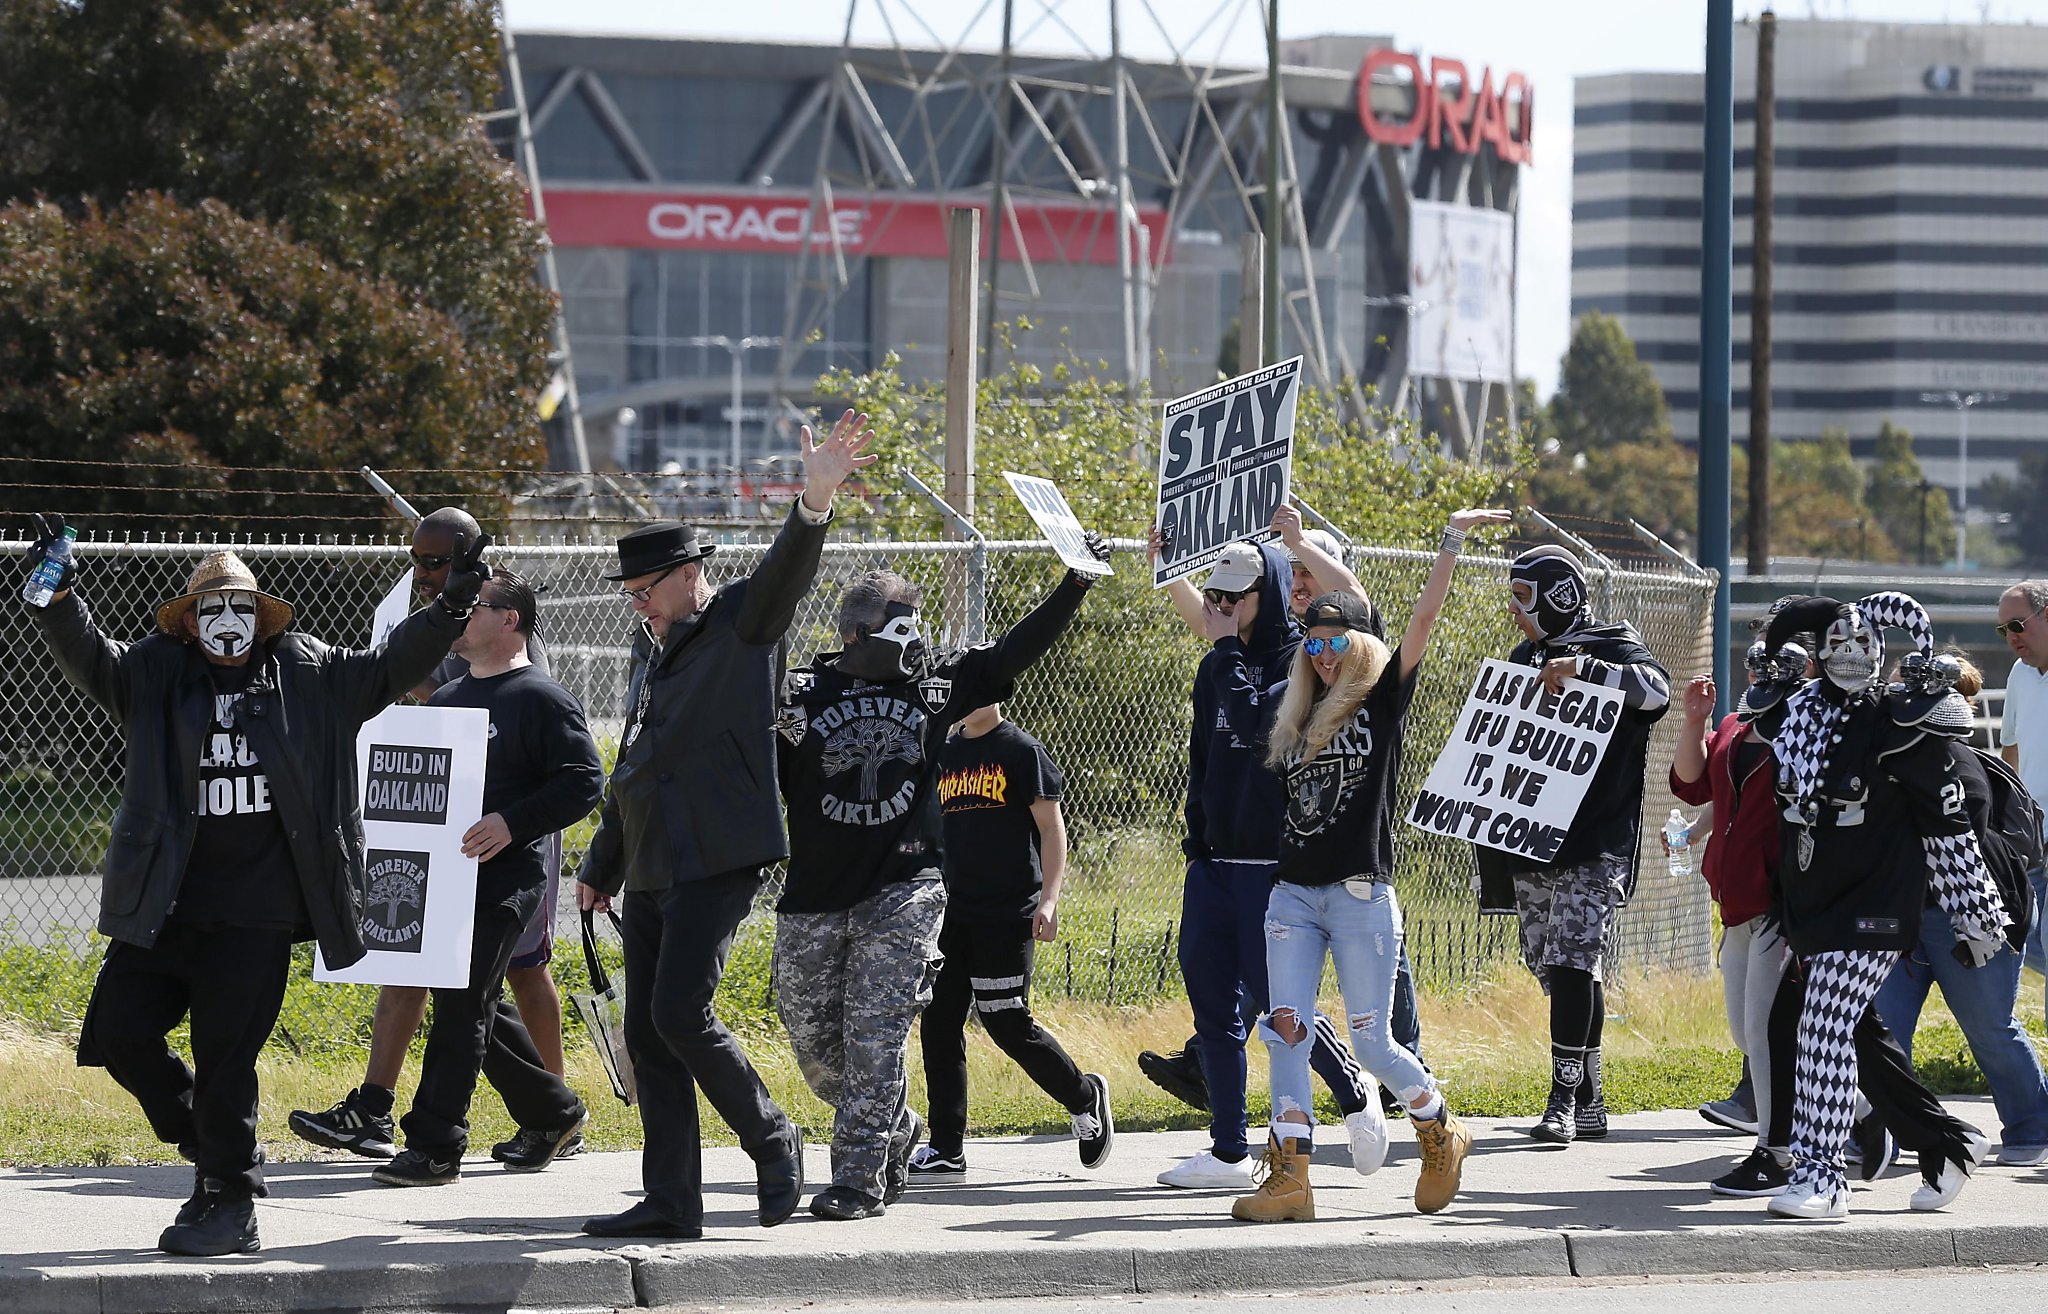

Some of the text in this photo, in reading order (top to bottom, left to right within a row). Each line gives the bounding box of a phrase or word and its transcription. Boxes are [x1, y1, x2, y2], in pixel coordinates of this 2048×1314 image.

[648, 202, 864, 245] ORACLE
[1168, 363, 1293, 416] COMMITMENT TO THE EAST BAY
[1164, 375, 1294, 479] STAY
[1217, 459, 1229, 482] IN
[1231, 444, 1287, 472] FOREVER OAKLAND
[1013, 479, 1069, 518] STAY
[1191, 471, 1215, 488] OAKLAND
[1161, 462, 1284, 565] OAKLAND
[927, 689, 946, 704] AL
[1474, 665, 1620, 735] LAS VEGAS
[811, 696, 926, 739] FOREVER
[200, 732, 260, 768] LAC
[373, 750, 447, 776] BUILD IN
[1507, 719, 1598, 776] BUILD
[367, 778, 447, 813] OAKLAND
[1463, 752, 1548, 808] IT, WE
[820, 779, 917, 827] OAKLAND
[1411, 789, 1568, 862] WON'T COME
[367, 858, 426, 886] FOREVER
[363, 918, 422, 944] OAKLAND
